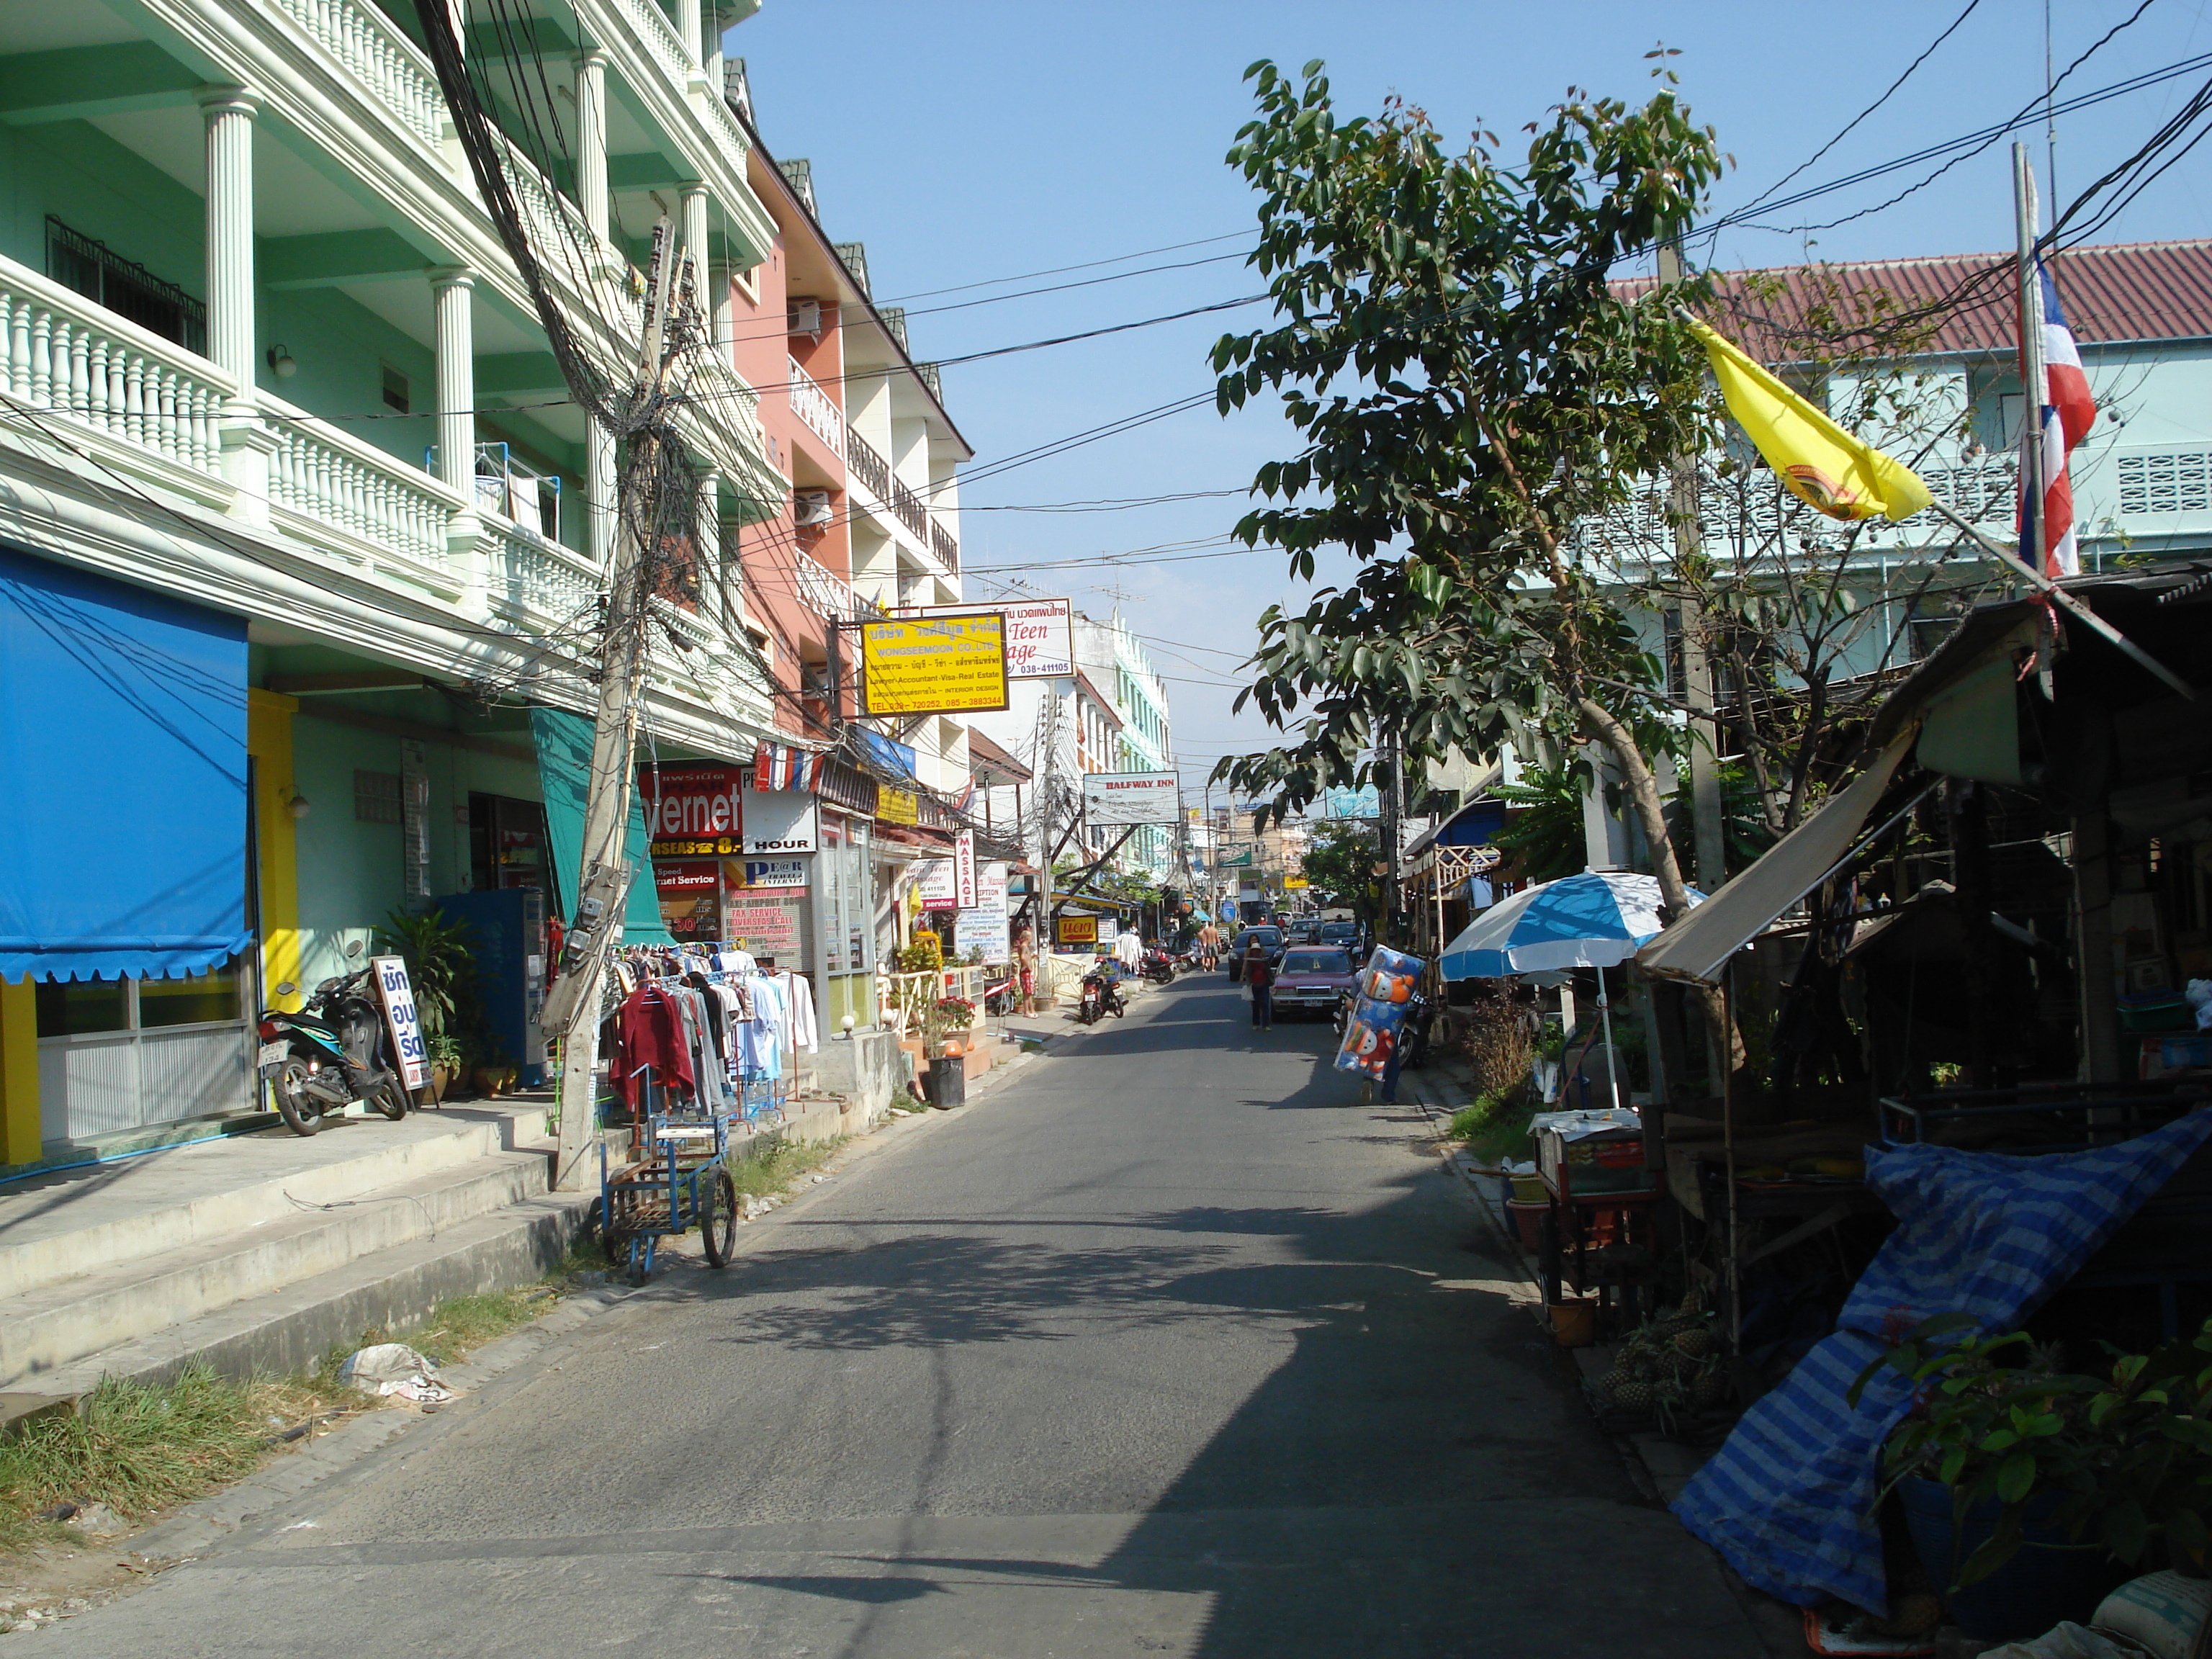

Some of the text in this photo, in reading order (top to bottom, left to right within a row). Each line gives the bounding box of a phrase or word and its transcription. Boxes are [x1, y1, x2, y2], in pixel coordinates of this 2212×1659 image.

[1009, 621, 1048, 640] Teen
[878, 644, 953, 657] WONGSEEMOON
[1006, 644, 1037, 665] age
[1020, 663, 1069, 674] 038-411105
[1105, 781, 1154, 790] HALFWAY
[755, 840, 809, 850] HOUR
[658, 868, 682, 877] Speed
[958, 837, 971, 905] MASSAGE
[678, 875, 715, 885] Service
[750, 908, 782, 917] SERVICE
[673, 917, 696, 932] 30
[383, 964, 408, 992] ซัก
[392, 1003, 416, 1025] อบ
[399, 1030, 424, 1057] รีด
